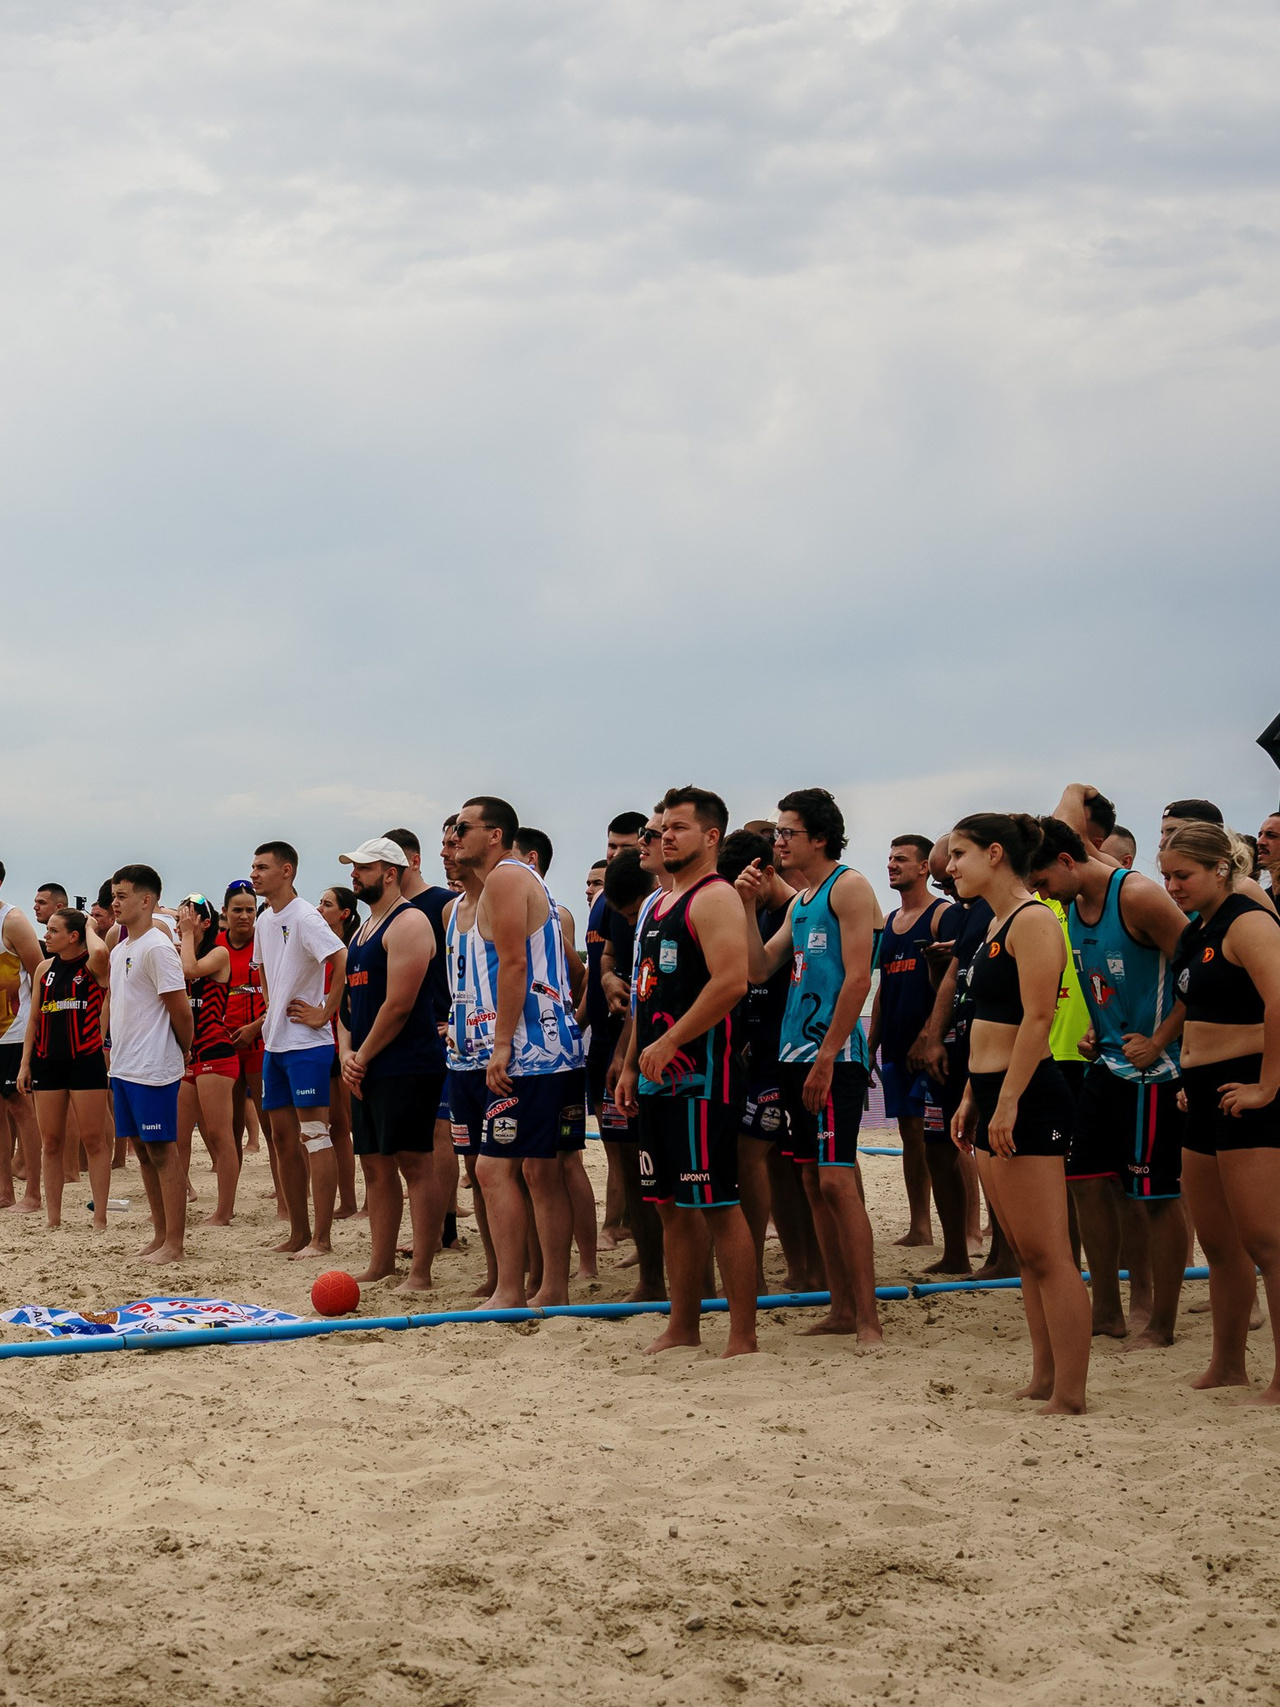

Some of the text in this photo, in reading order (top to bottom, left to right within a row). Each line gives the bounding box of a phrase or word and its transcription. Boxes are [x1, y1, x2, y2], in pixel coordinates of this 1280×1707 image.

[458, 955, 466, 979] 9
[46, 972, 55, 986] 6
[486, 1097, 519, 1120] IVASPED
